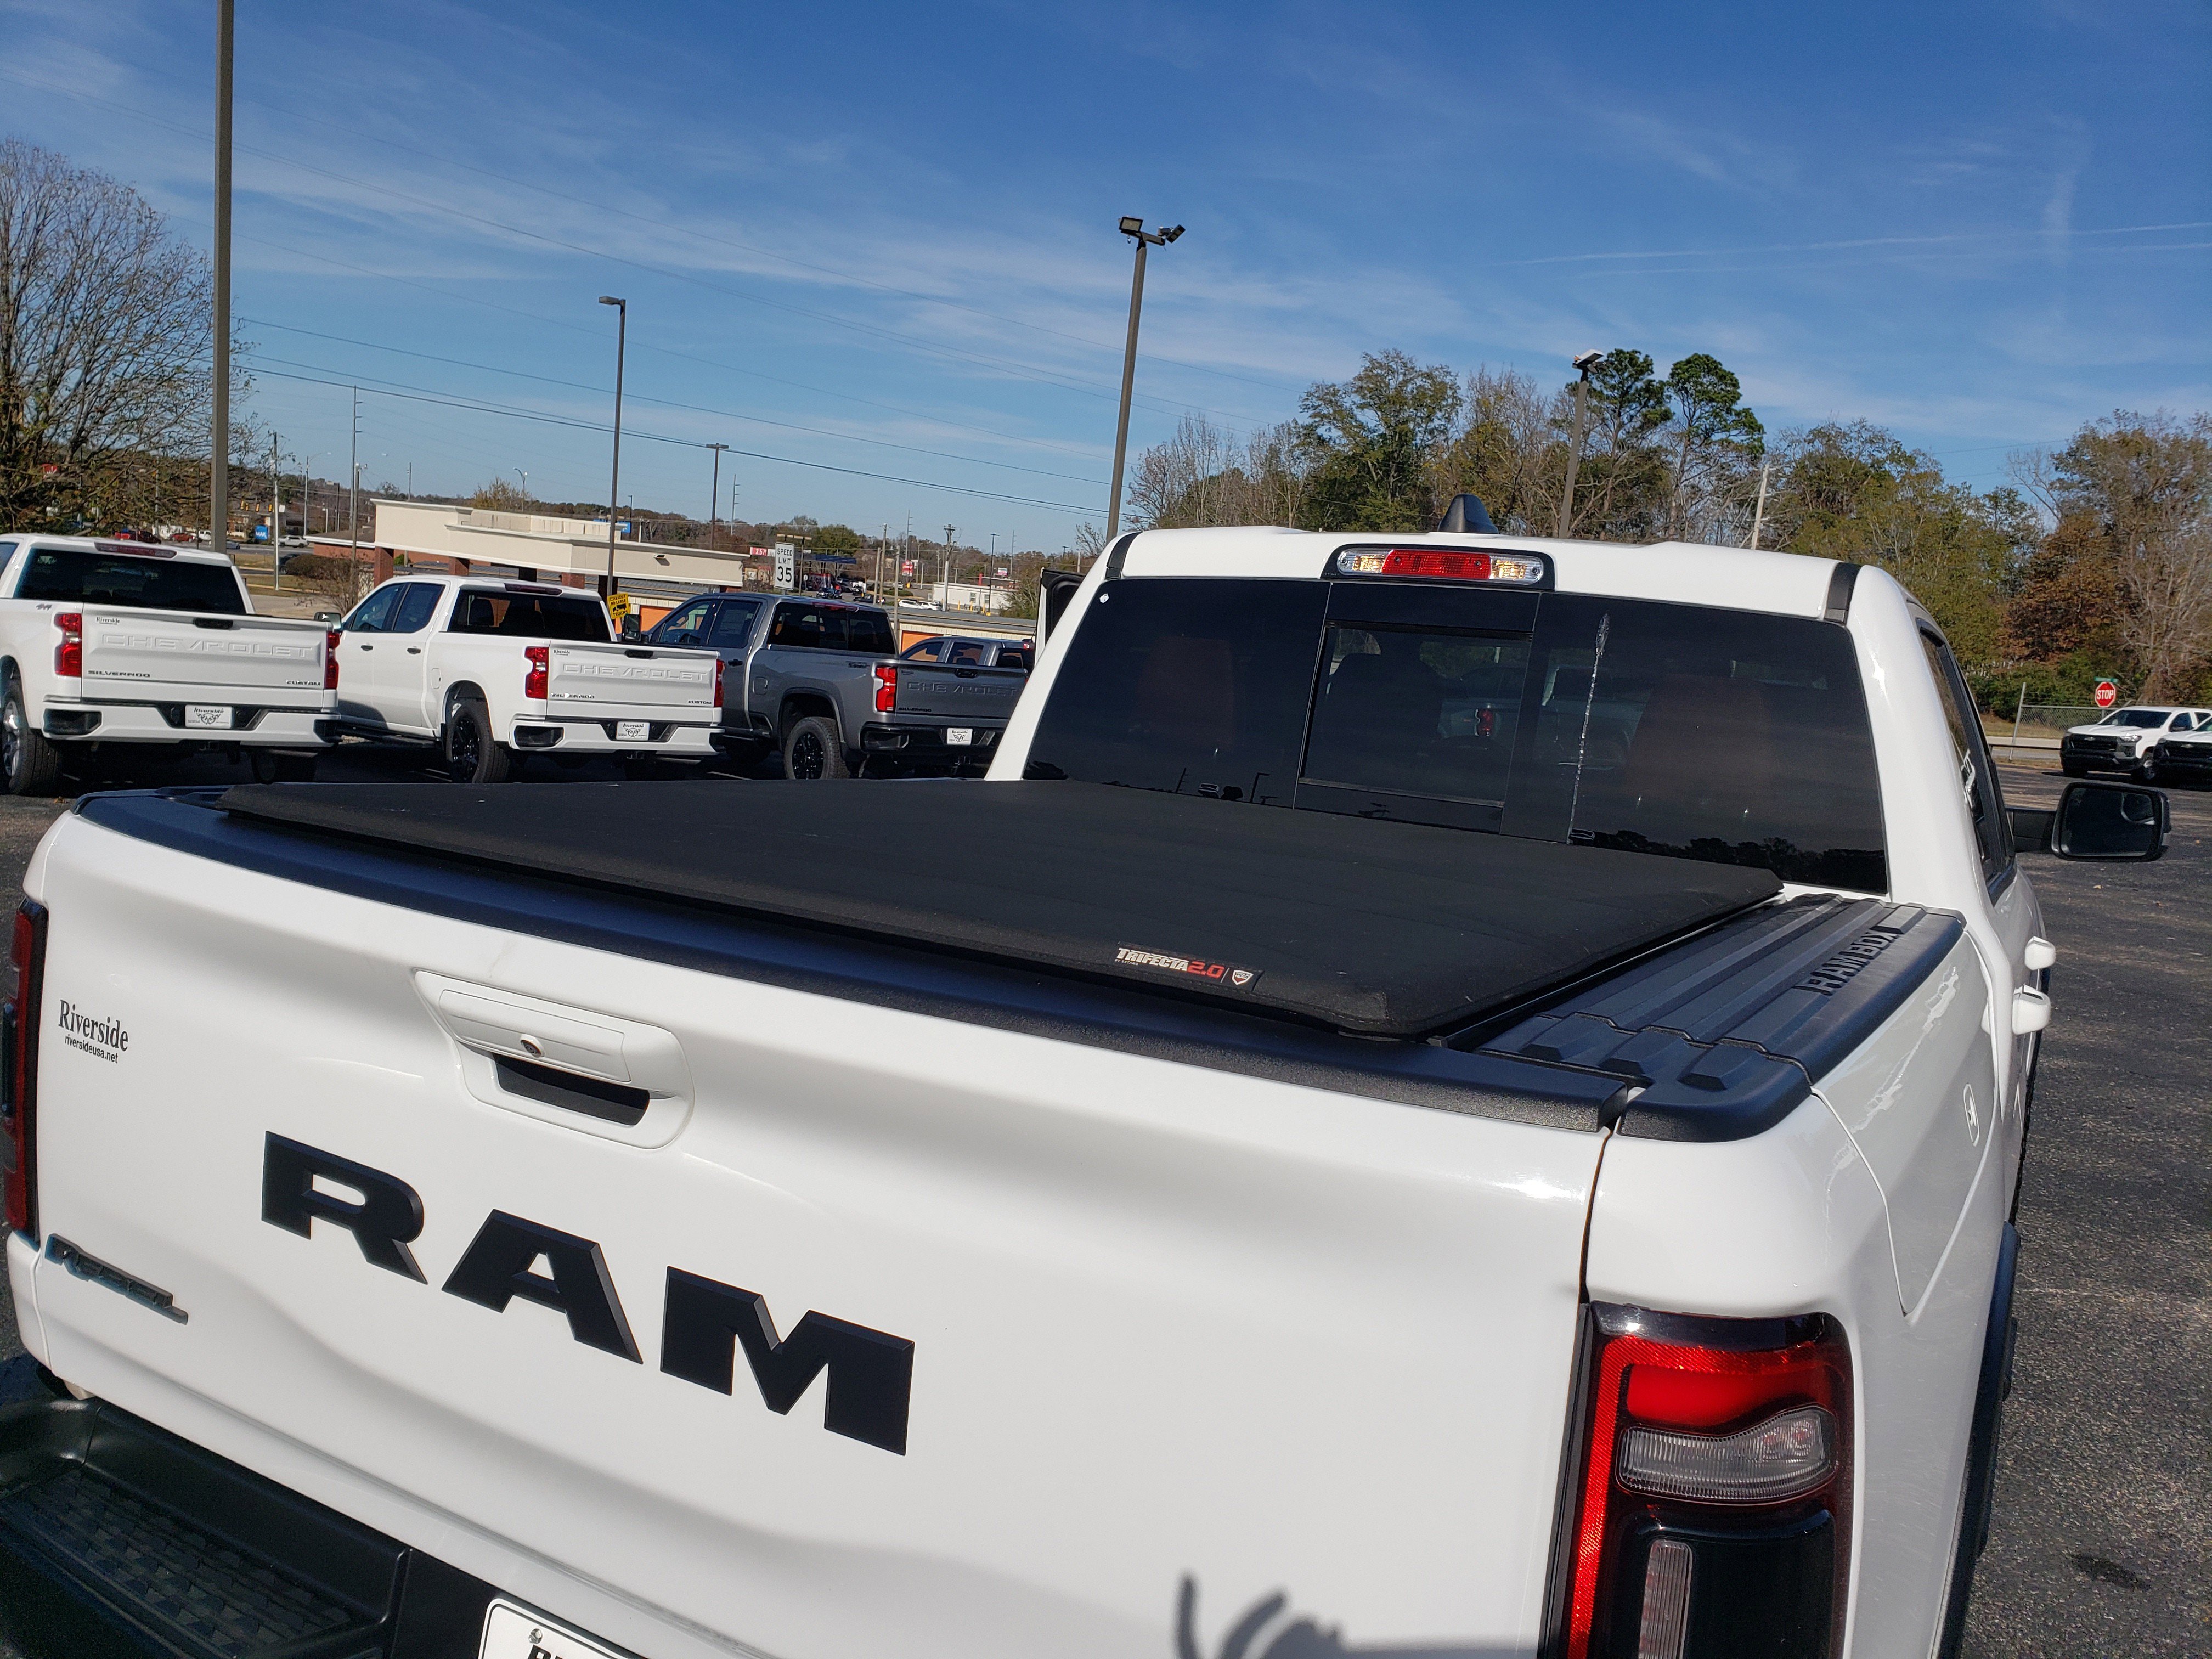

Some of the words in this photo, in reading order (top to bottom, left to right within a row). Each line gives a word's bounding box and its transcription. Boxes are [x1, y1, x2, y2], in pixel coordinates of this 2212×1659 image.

[777, 548, 793, 556] SPEED
[777, 566, 792, 582] 35
[102, 634, 312, 657] CHEVROLET
[88, 670, 151, 678] SILVERADO
[563, 663, 707, 681] CHEVROLET
[907, 681, 1017, 697] CHEVROLET
[2096, 690, 2114, 699] STOP
[1791, 932, 1900, 996] RAMBOX
[58, 999, 128, 1052] Riverside
[65, 1034, 119, 1064] riversideusa.net
[261, 1131, 915, 1456] RAM
